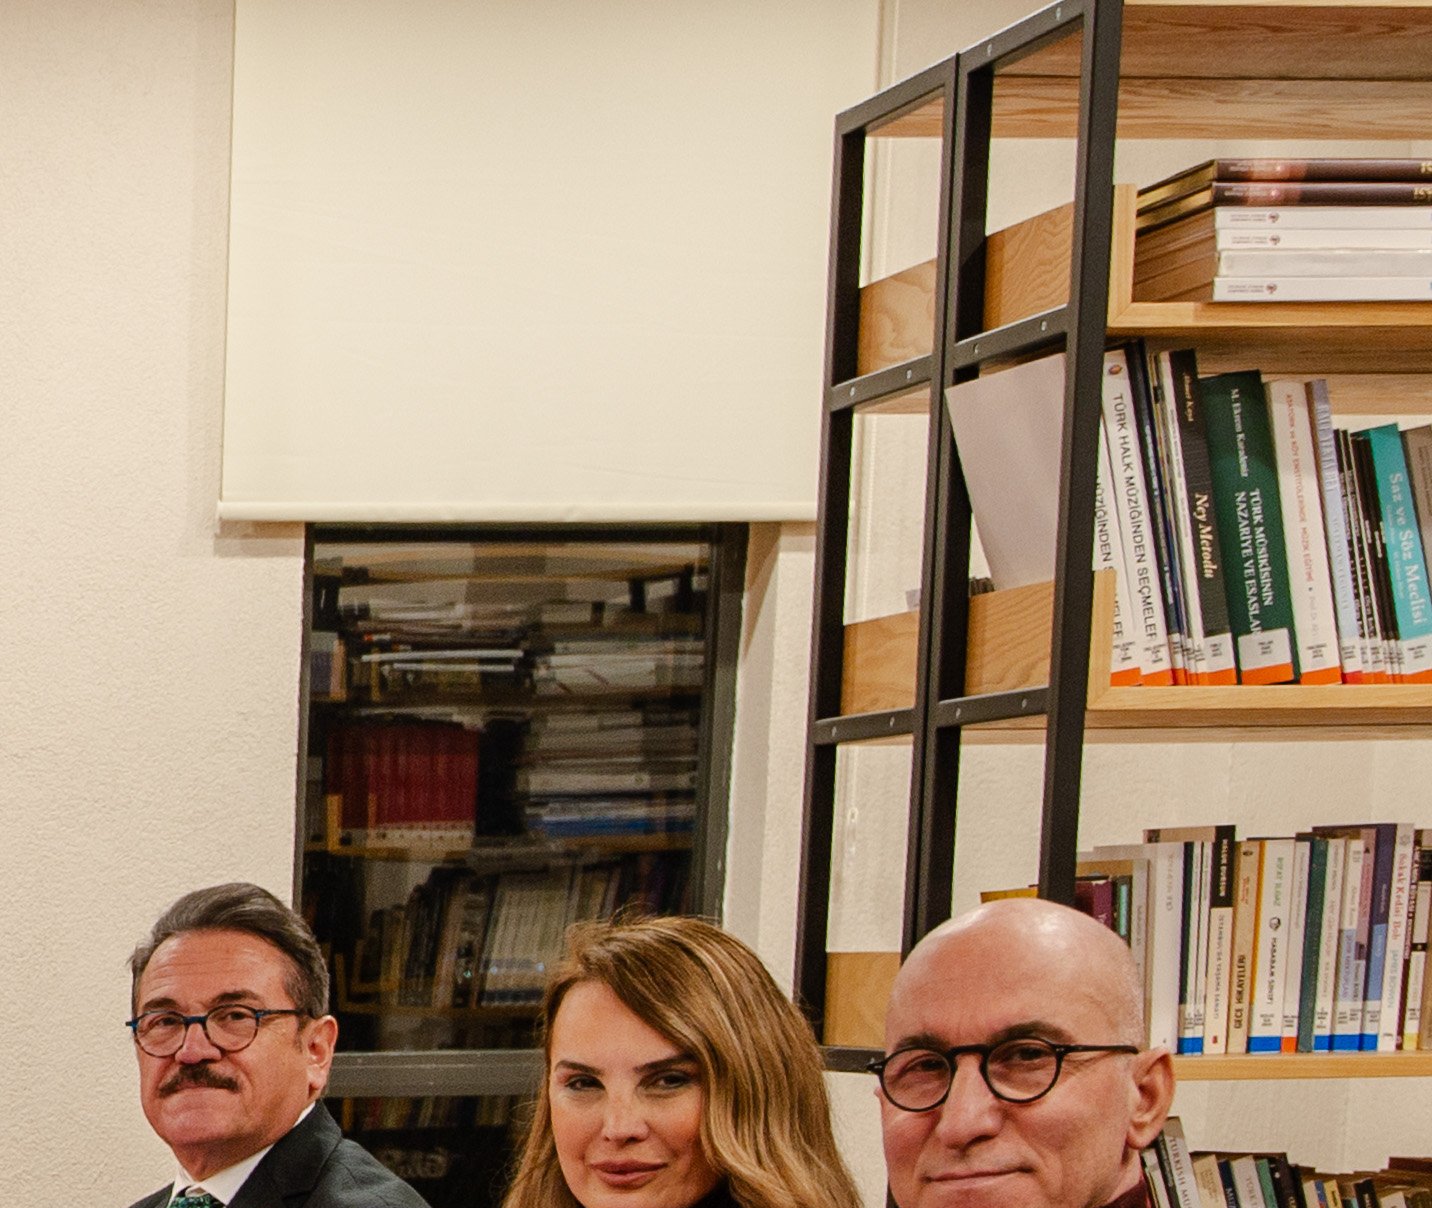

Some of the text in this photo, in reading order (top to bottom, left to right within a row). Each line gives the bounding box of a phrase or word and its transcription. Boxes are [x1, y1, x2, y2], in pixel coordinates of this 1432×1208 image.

[1112, 394, 1129, 431] TÜRK
[1118, 435, 1134, 472] HALK
[1389, 472, 1405, 501] Saz
[1232, 491, 1254, 558] NAZARİYE
[1248, 489, 1264, 524] TÜRK
[1396, 507, 1407, 525] ve
[1191, 491, 1220, 579] Ney Metodu
[1400, 530, 1415, 560] Söz
[1242, 560, 1256, 579] VE
[1405, 564, 1428, 625] Meclisi
